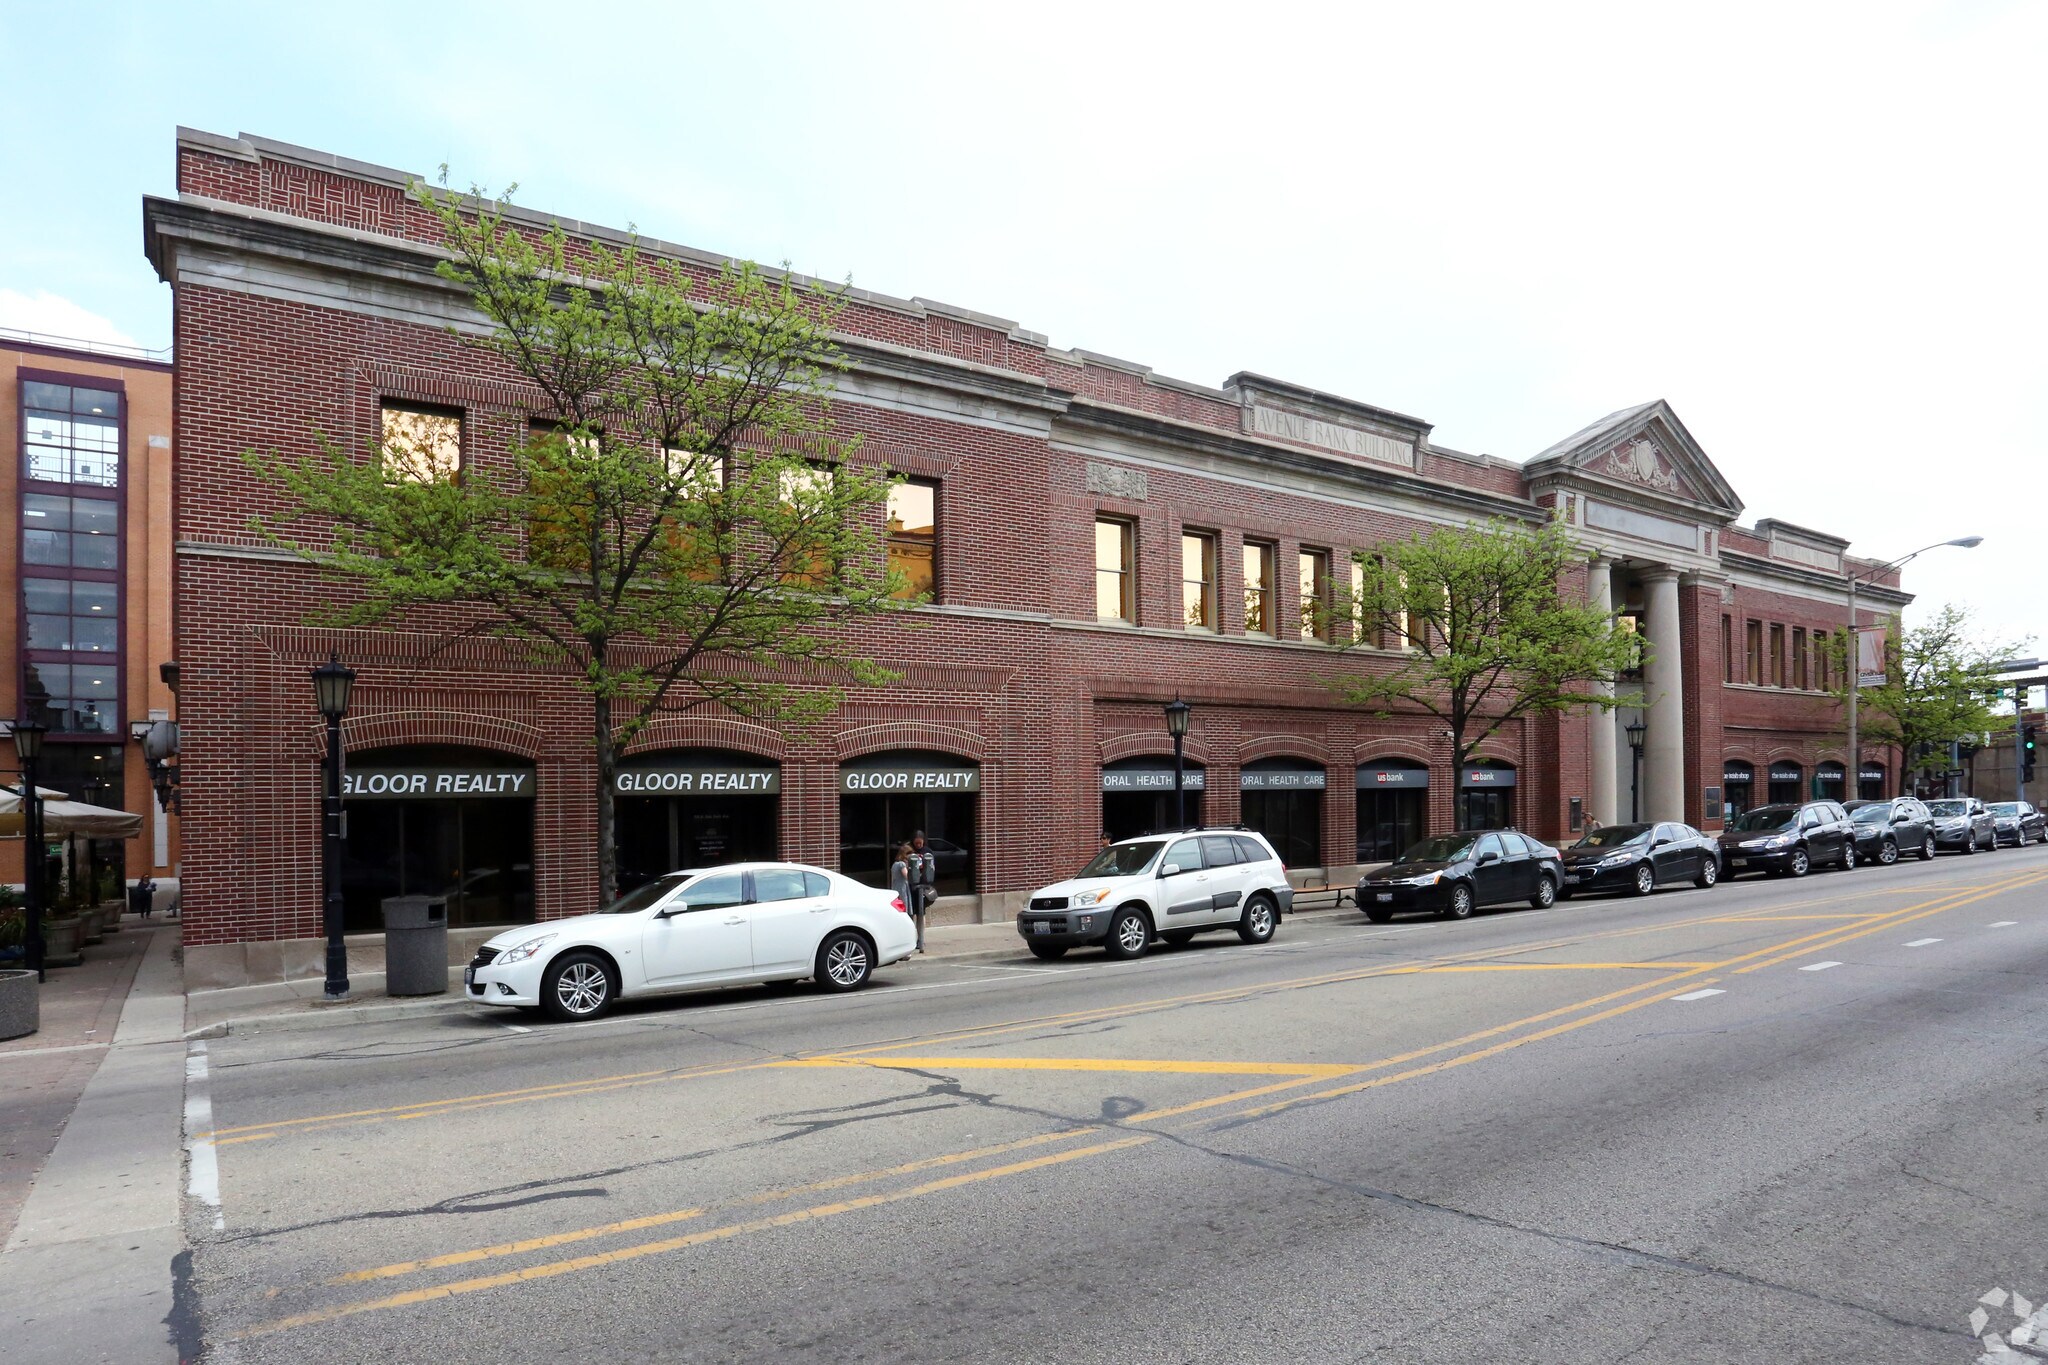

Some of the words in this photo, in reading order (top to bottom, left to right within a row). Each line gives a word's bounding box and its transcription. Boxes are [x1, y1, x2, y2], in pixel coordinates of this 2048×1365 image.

[1257, 410, 1310, 441] AVENUE
[1315, 422, 1350, 451] BANK
[1355, 432, 1411, 465] BUILDING
[435, 774, 525, 792] REALTY
[617, 773, 693, 790] GLOOR
[699, 773, 772, 790] REALTY
[846, 773, 908, 789] GLOOR
[913, 773, 972, 788] REALTY
[1104, 775, 1131, 786] ORAL
[1136, 775, 1172, 785] HEALTH
[1241, 775, 1264, 785] ORAL
[1269, 775, 1299, 785] HEALTH
[1304, 775, 1325, 785] CARE
